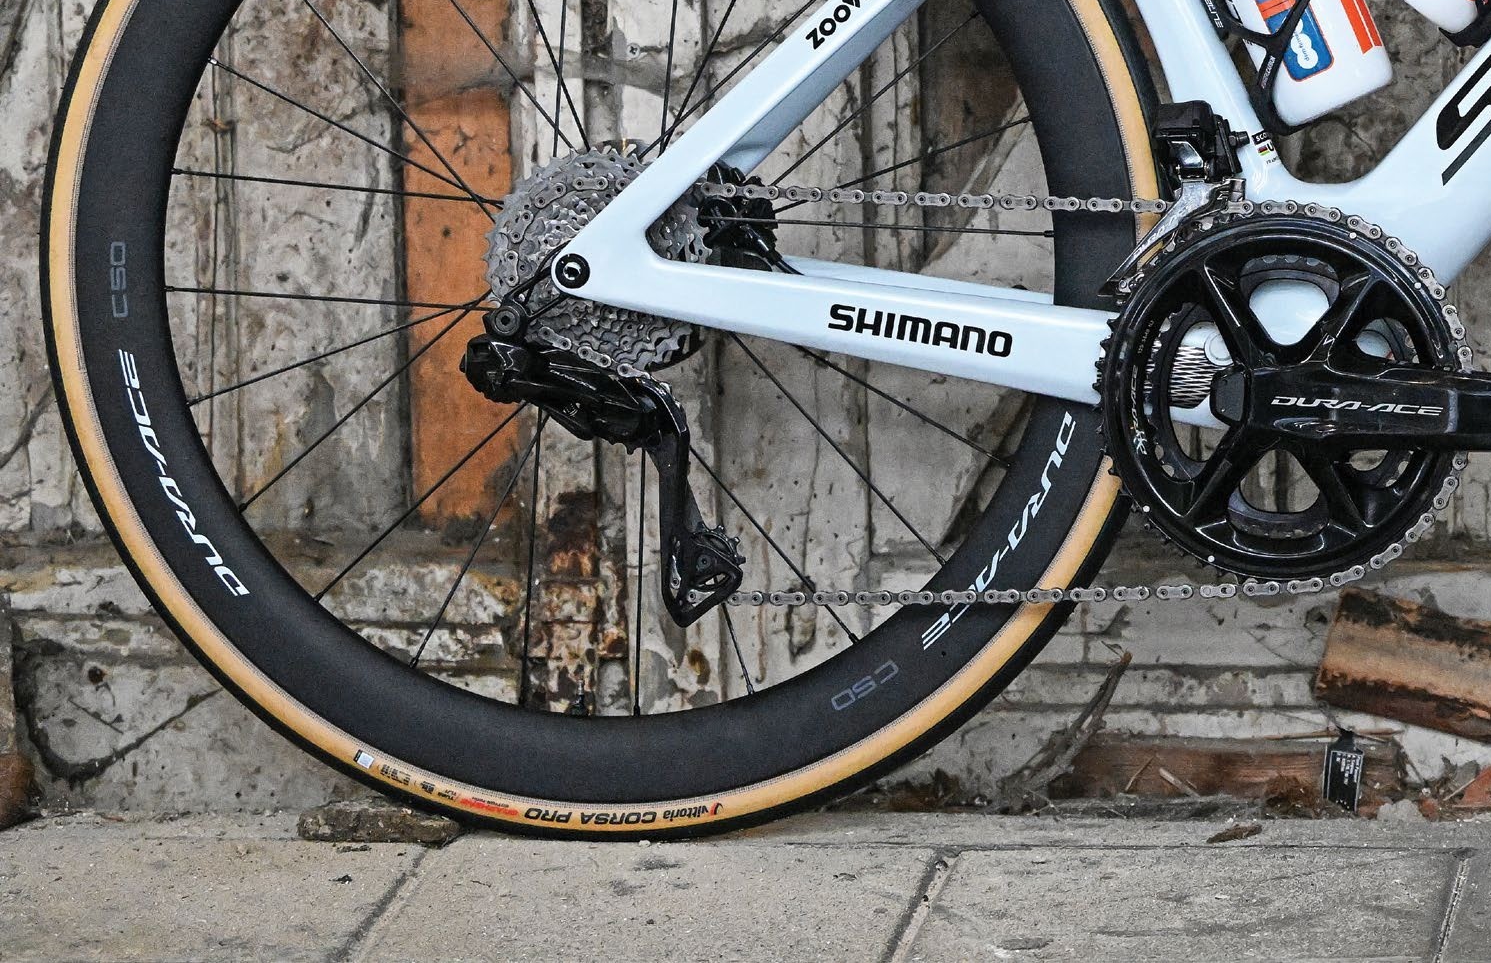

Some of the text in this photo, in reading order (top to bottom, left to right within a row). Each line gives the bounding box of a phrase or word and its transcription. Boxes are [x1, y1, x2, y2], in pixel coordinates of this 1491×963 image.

[109, 241, 129, 318] C50
[828, 303, 1013, 358] SHIMANO
[1271, 395, 1444, 416] DURA-ACE
[118, 348, 251, 597] DURA-ACE
[831, 659, 899, 712] C50
[524, 804, 709, 826] vittoria CORSA PRO
